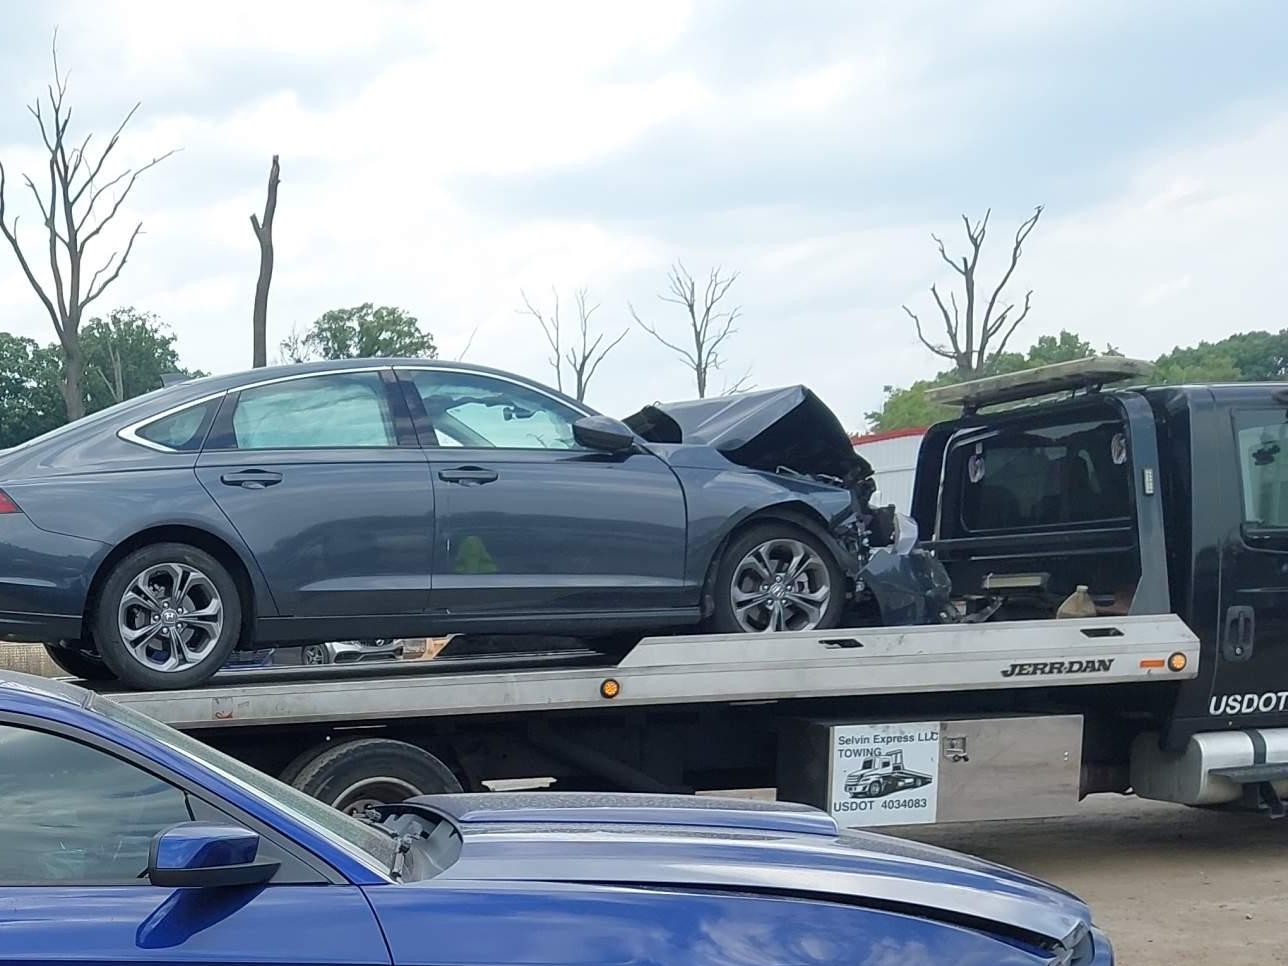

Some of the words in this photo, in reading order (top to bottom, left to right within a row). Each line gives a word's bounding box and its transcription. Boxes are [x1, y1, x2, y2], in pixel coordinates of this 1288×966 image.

[1209, 691, 1288, 716] USDOT
[839, 735, 870, 745] Selvin
[873, 734, 915, 746] Express
[918, 732, 939, 741] LLC
[838, 748, 882, 758] TOWING
[833, 801, 875, 812] USDOT
[881, 799, 928, 810] 4034083
